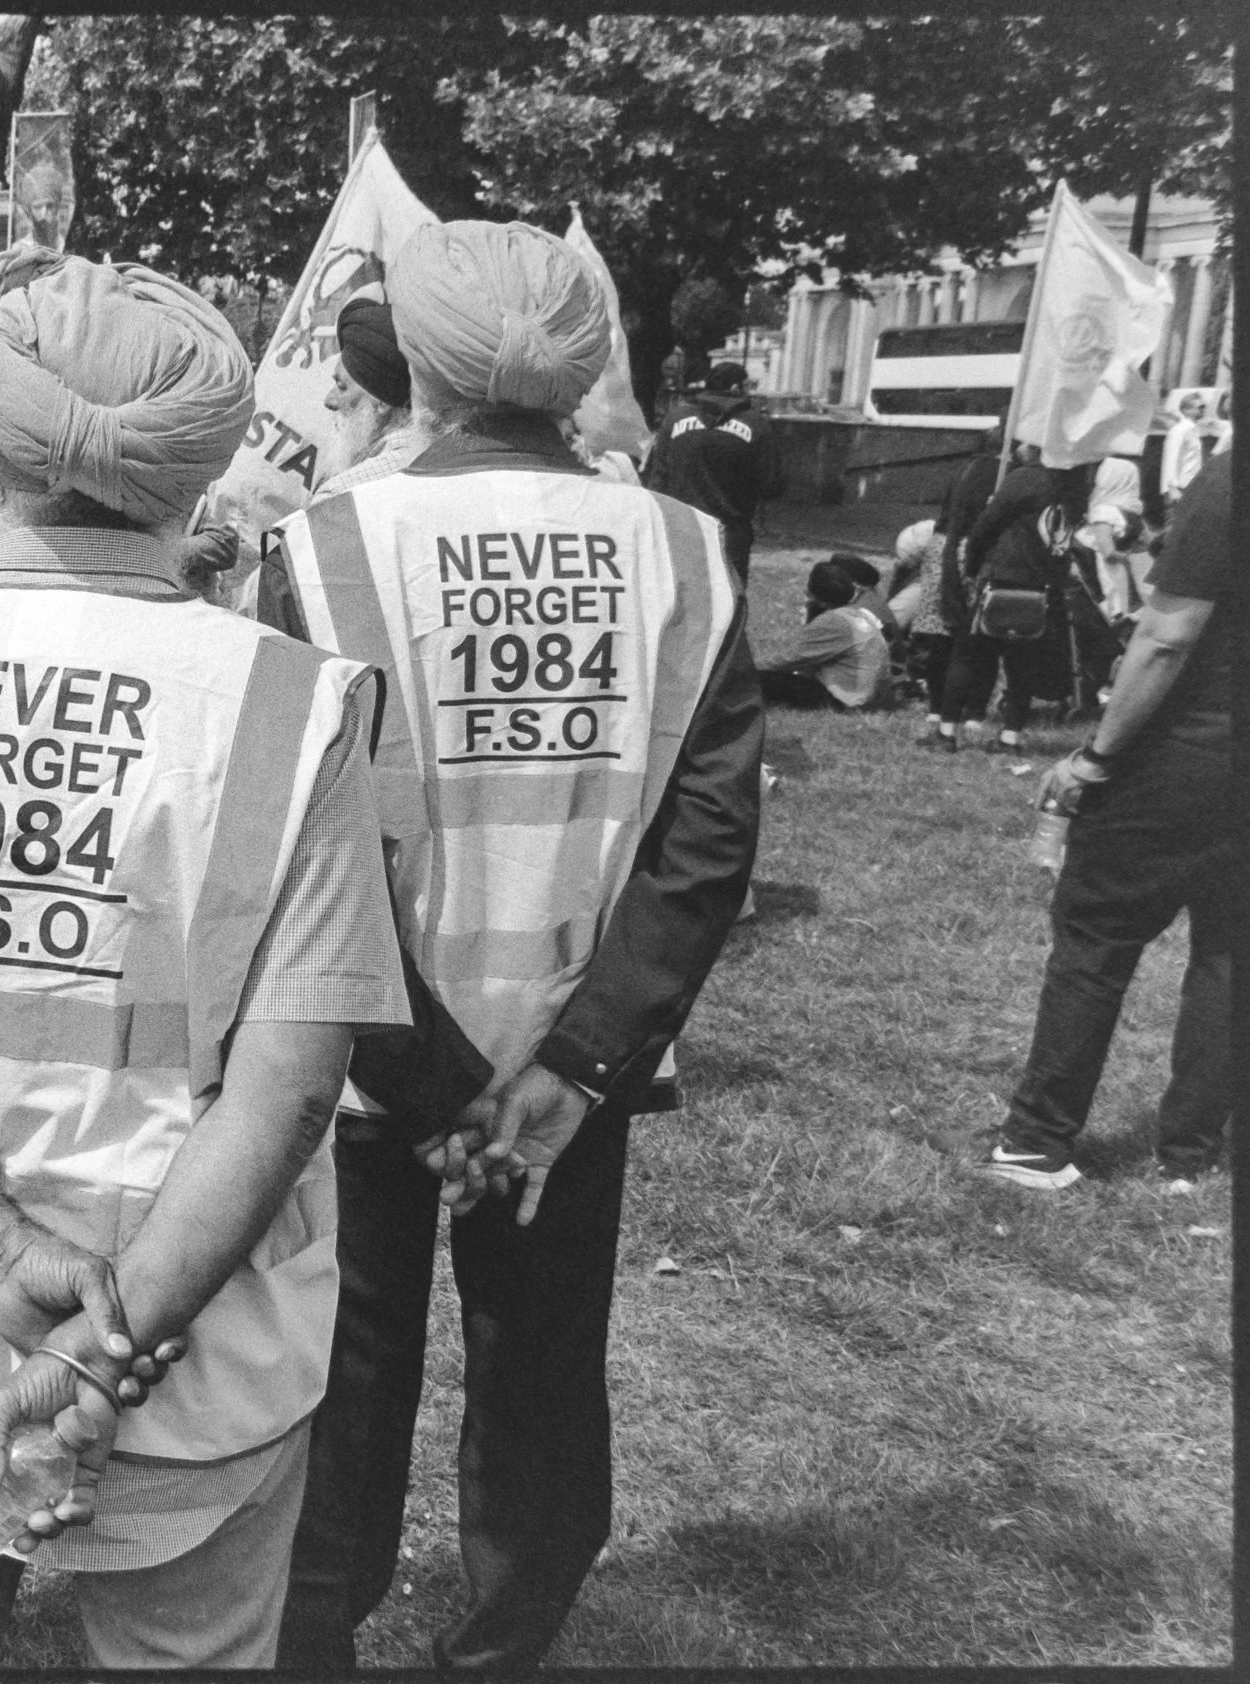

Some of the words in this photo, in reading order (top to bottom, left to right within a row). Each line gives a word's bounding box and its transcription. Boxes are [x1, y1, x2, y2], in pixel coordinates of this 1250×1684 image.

[242, 411, 325, 494] STA
[436, 532, 624, 583] NEVER
[441, 585, 626, 628] FORGET
[450, 631, 618, 693] 1984
[465, 706, 599, 753] F.S.O
